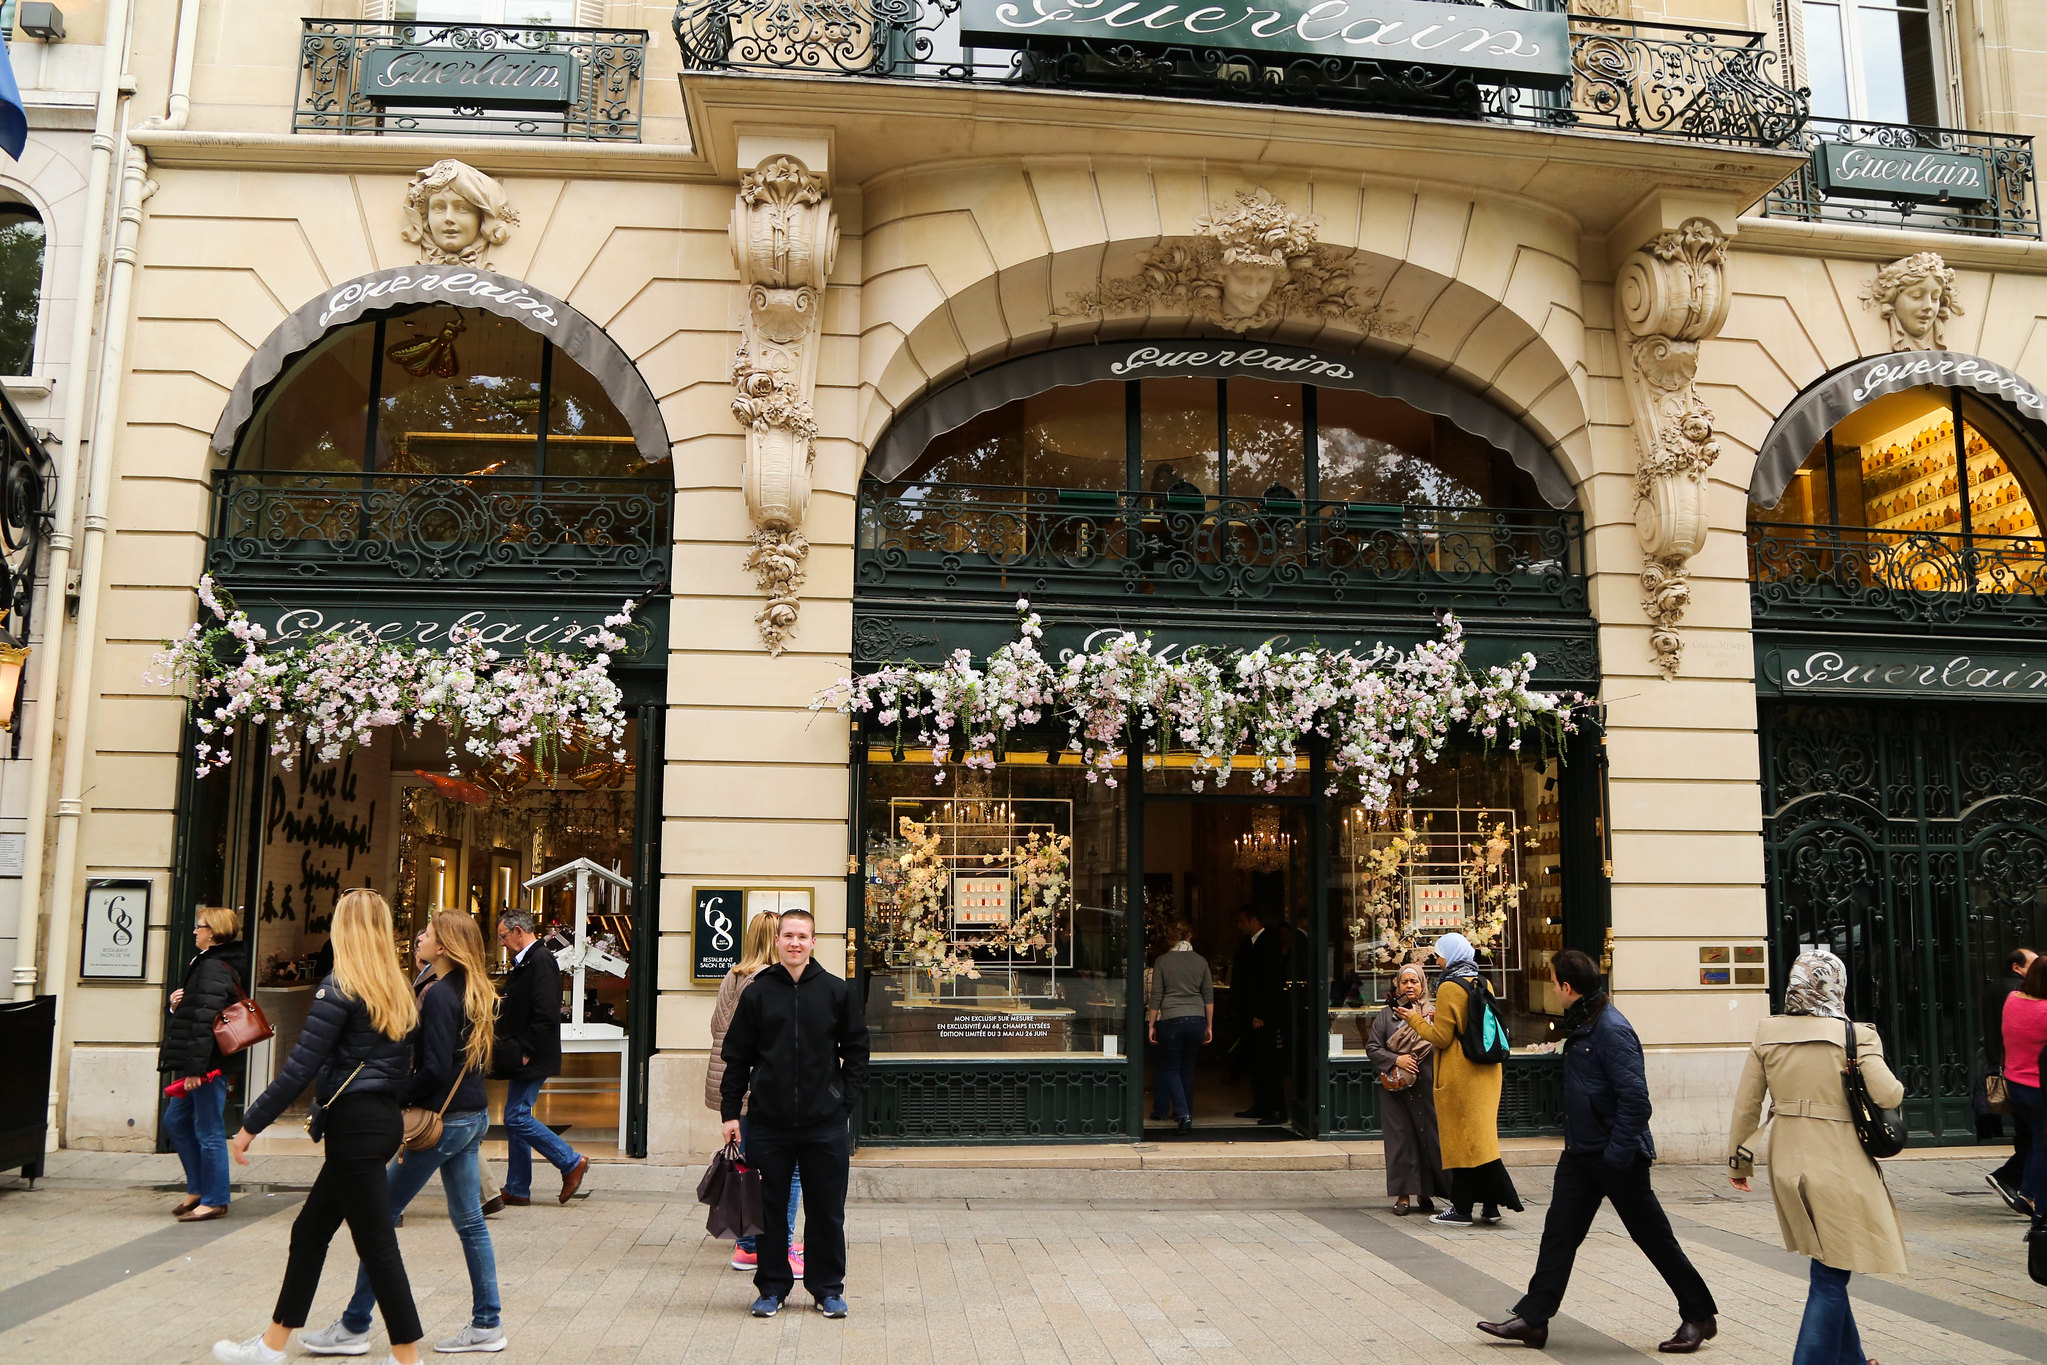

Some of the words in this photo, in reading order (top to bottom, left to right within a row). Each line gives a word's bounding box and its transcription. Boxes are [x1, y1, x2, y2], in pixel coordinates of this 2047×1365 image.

[996, 0, 1540, 57] Guerlain
[377, 52, 560, 88] Guerlain
[1836, 149, 1980, 187] Guerlain
[319, 273, 558, 327] Guerlain
[1111, 346, 1355, 380] Guerlain
[1853, 359, 2044, 410] Guerlain
[266, 608, 606, 646] Guerlain
[107, 895, 133, 947] 68
[704, 896, 734, 952] 68
[946, 1022, 981, 1030] EXCLUSIVITÉ
[992, 1023, 1001, 1031] 68,
